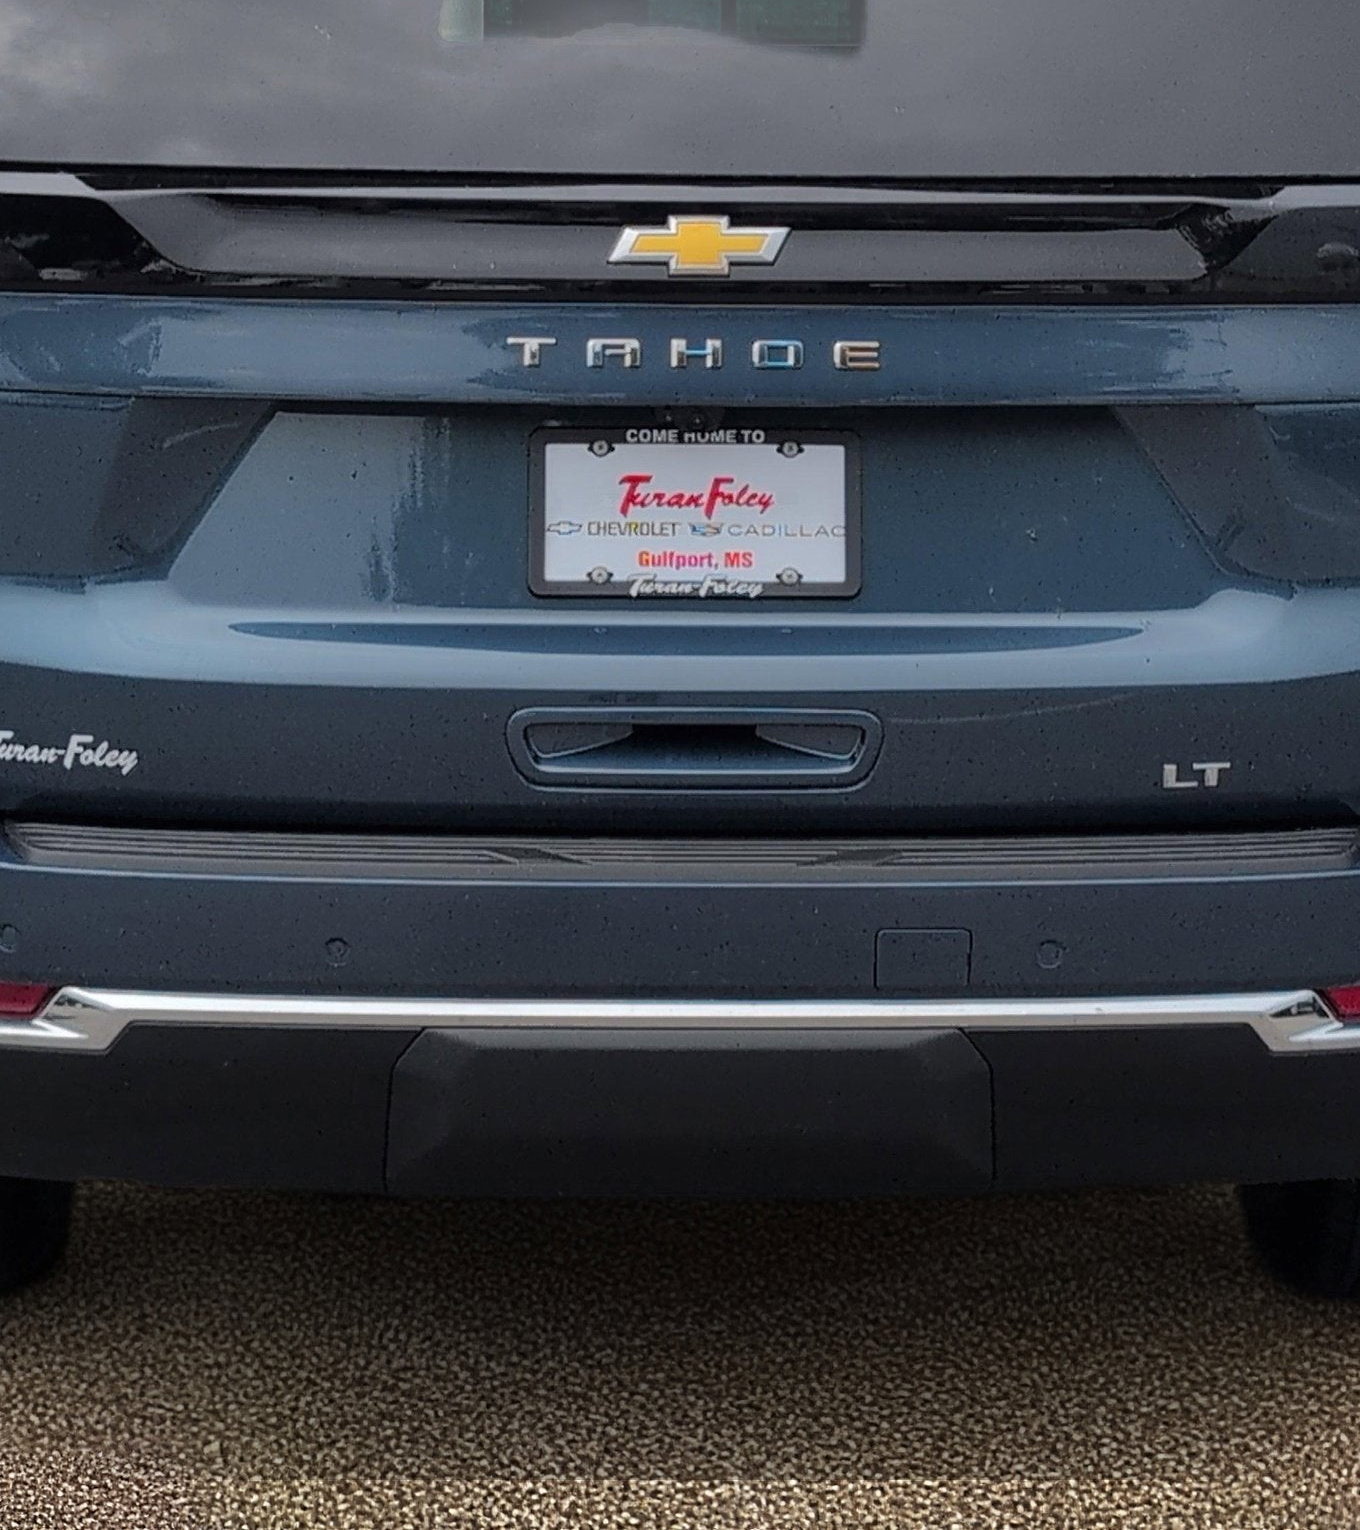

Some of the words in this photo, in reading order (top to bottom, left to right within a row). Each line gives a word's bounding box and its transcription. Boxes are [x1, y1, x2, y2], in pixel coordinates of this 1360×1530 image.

[506, 337, 881, 370] TAHOE
[625, 428, 679, 443] COME
[683, 428, 737, 443] HOME
[740, 428, 766, 443] TO
[587, 522, 680, 537] CHEVROLET
[728, 523, 847, 538] CADILLAC
[638, 550, 719, 570] Gulfport,
[724, 551, 754, 568] MS
[1163, 761, 1232, 788] LT
